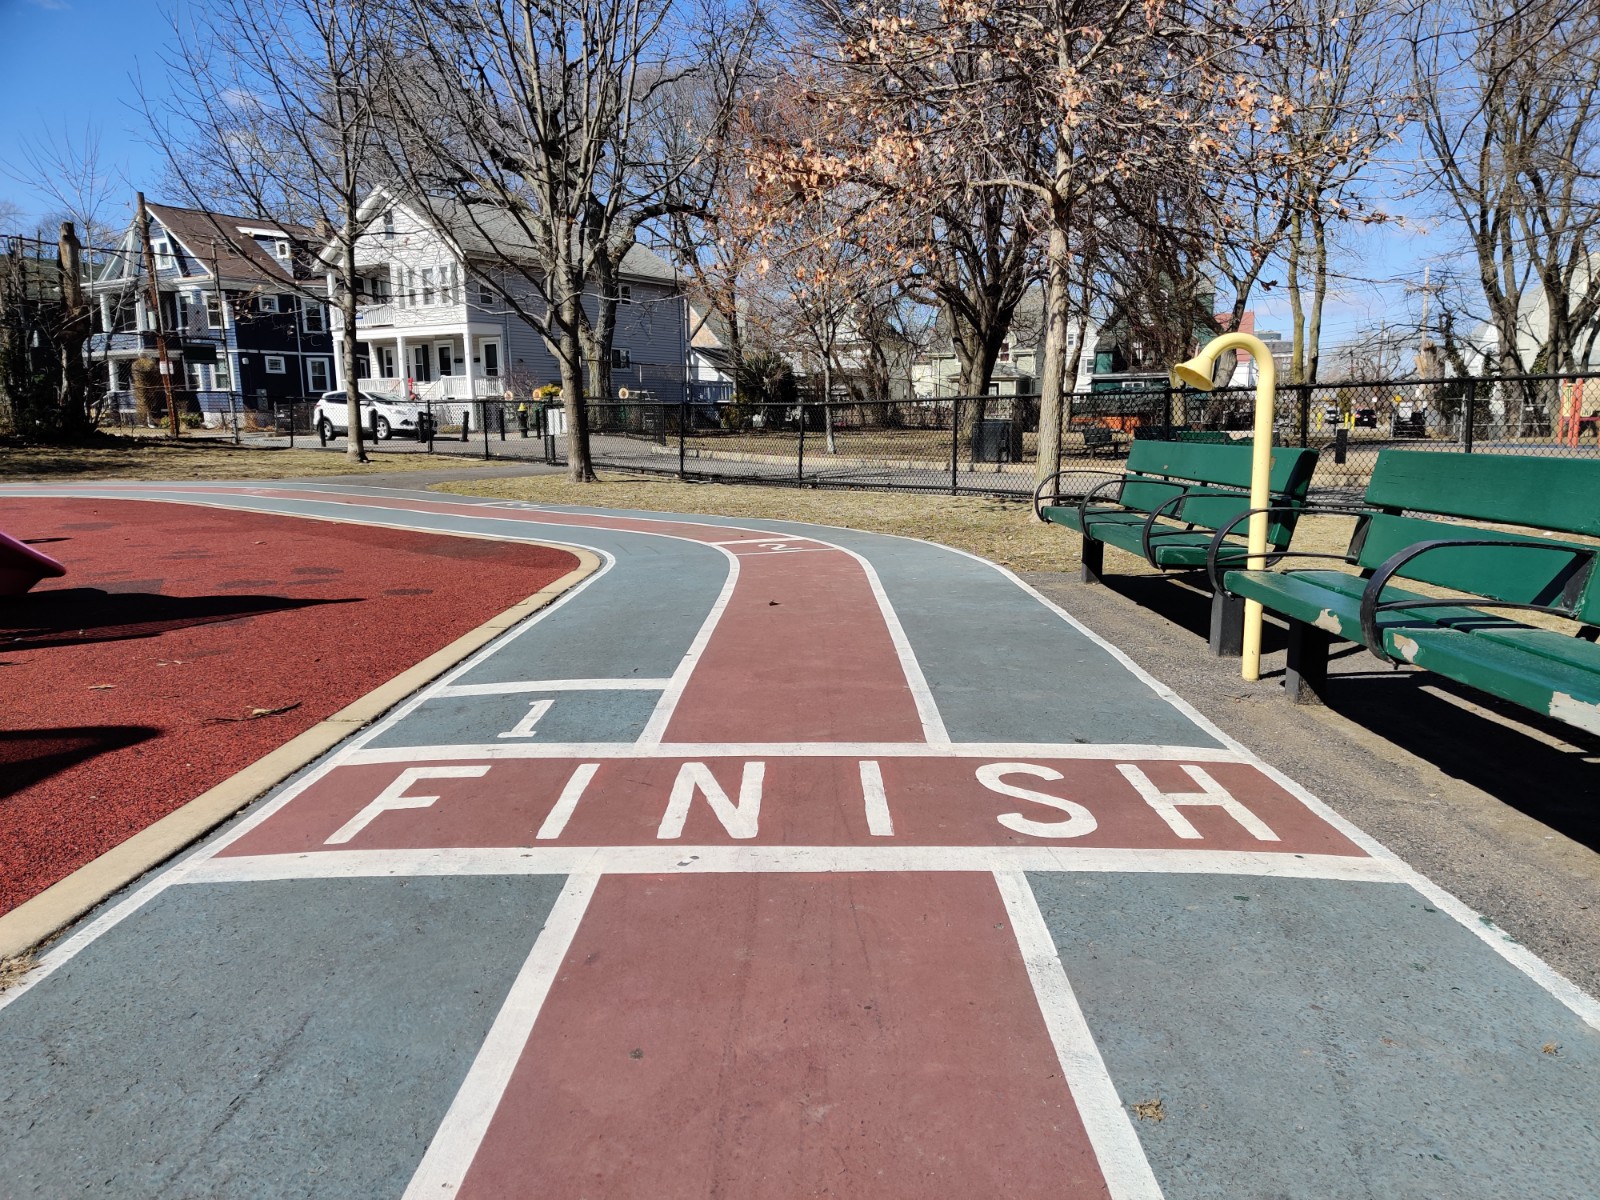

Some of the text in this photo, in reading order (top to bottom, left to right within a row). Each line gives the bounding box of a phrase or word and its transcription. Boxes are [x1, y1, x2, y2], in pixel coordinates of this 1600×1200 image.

[758, 543, 802, 551] 2
[497, 699, 555, 738] 1
[323, 760, 1282, 845] FINISH
